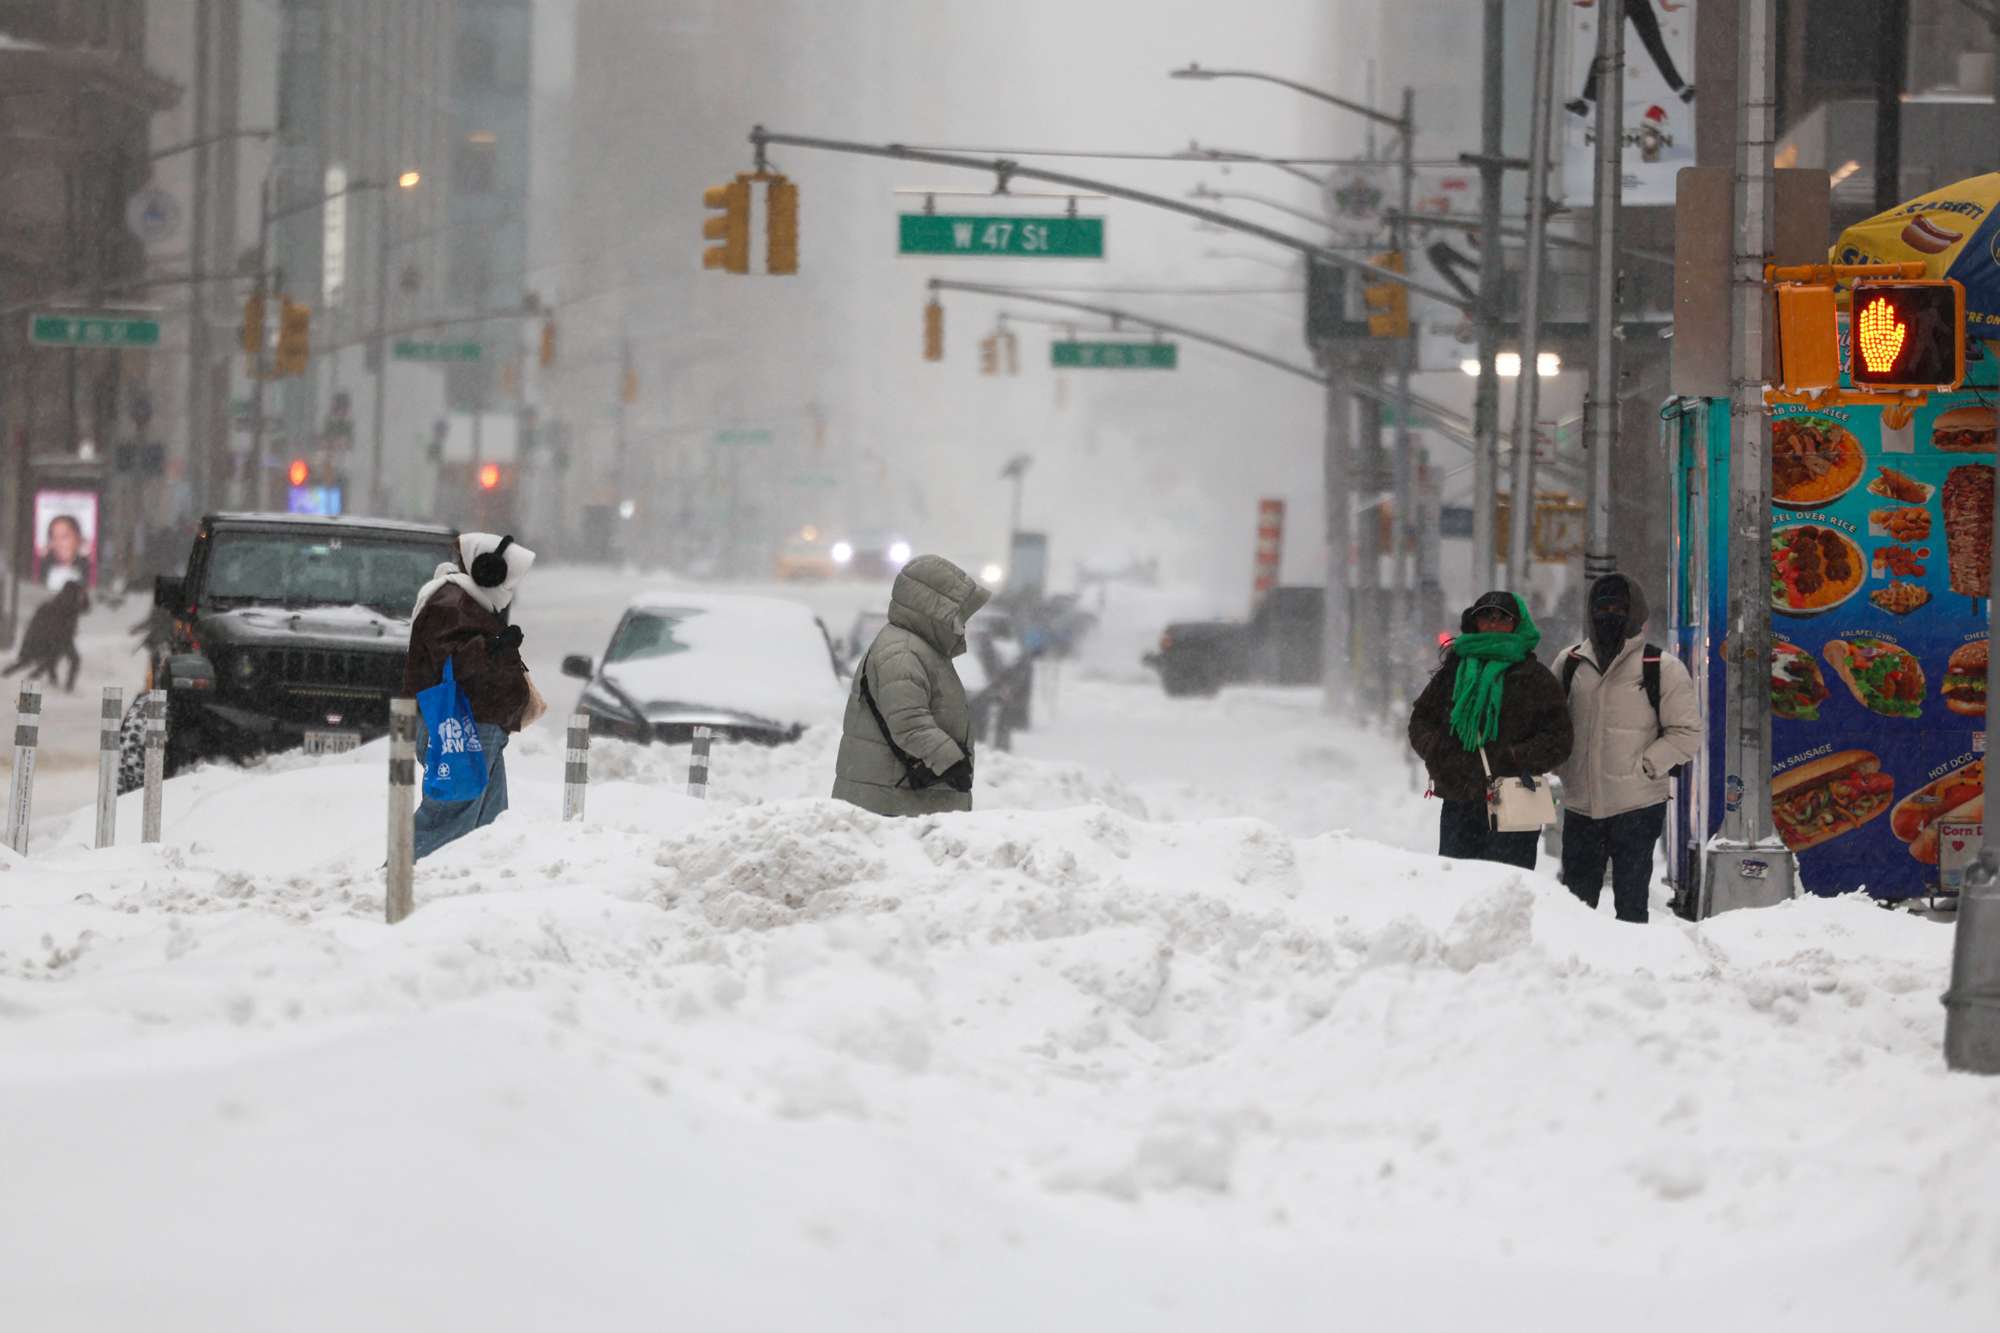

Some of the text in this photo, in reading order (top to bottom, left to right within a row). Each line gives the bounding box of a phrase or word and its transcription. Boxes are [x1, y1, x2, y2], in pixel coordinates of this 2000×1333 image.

[953, 223, 1048, 250] W 47 St
[1823, 408, 1849, 421] RICE
[1796, 511, 1825, 521] OVER
[1830, 516, 1856, 533] RICE
[1787, 743, 1833, 766] SAUSAGE
[1928, 752, 1974, 779] HOT DOG
[1942, 826, 1973, 836] Corn
